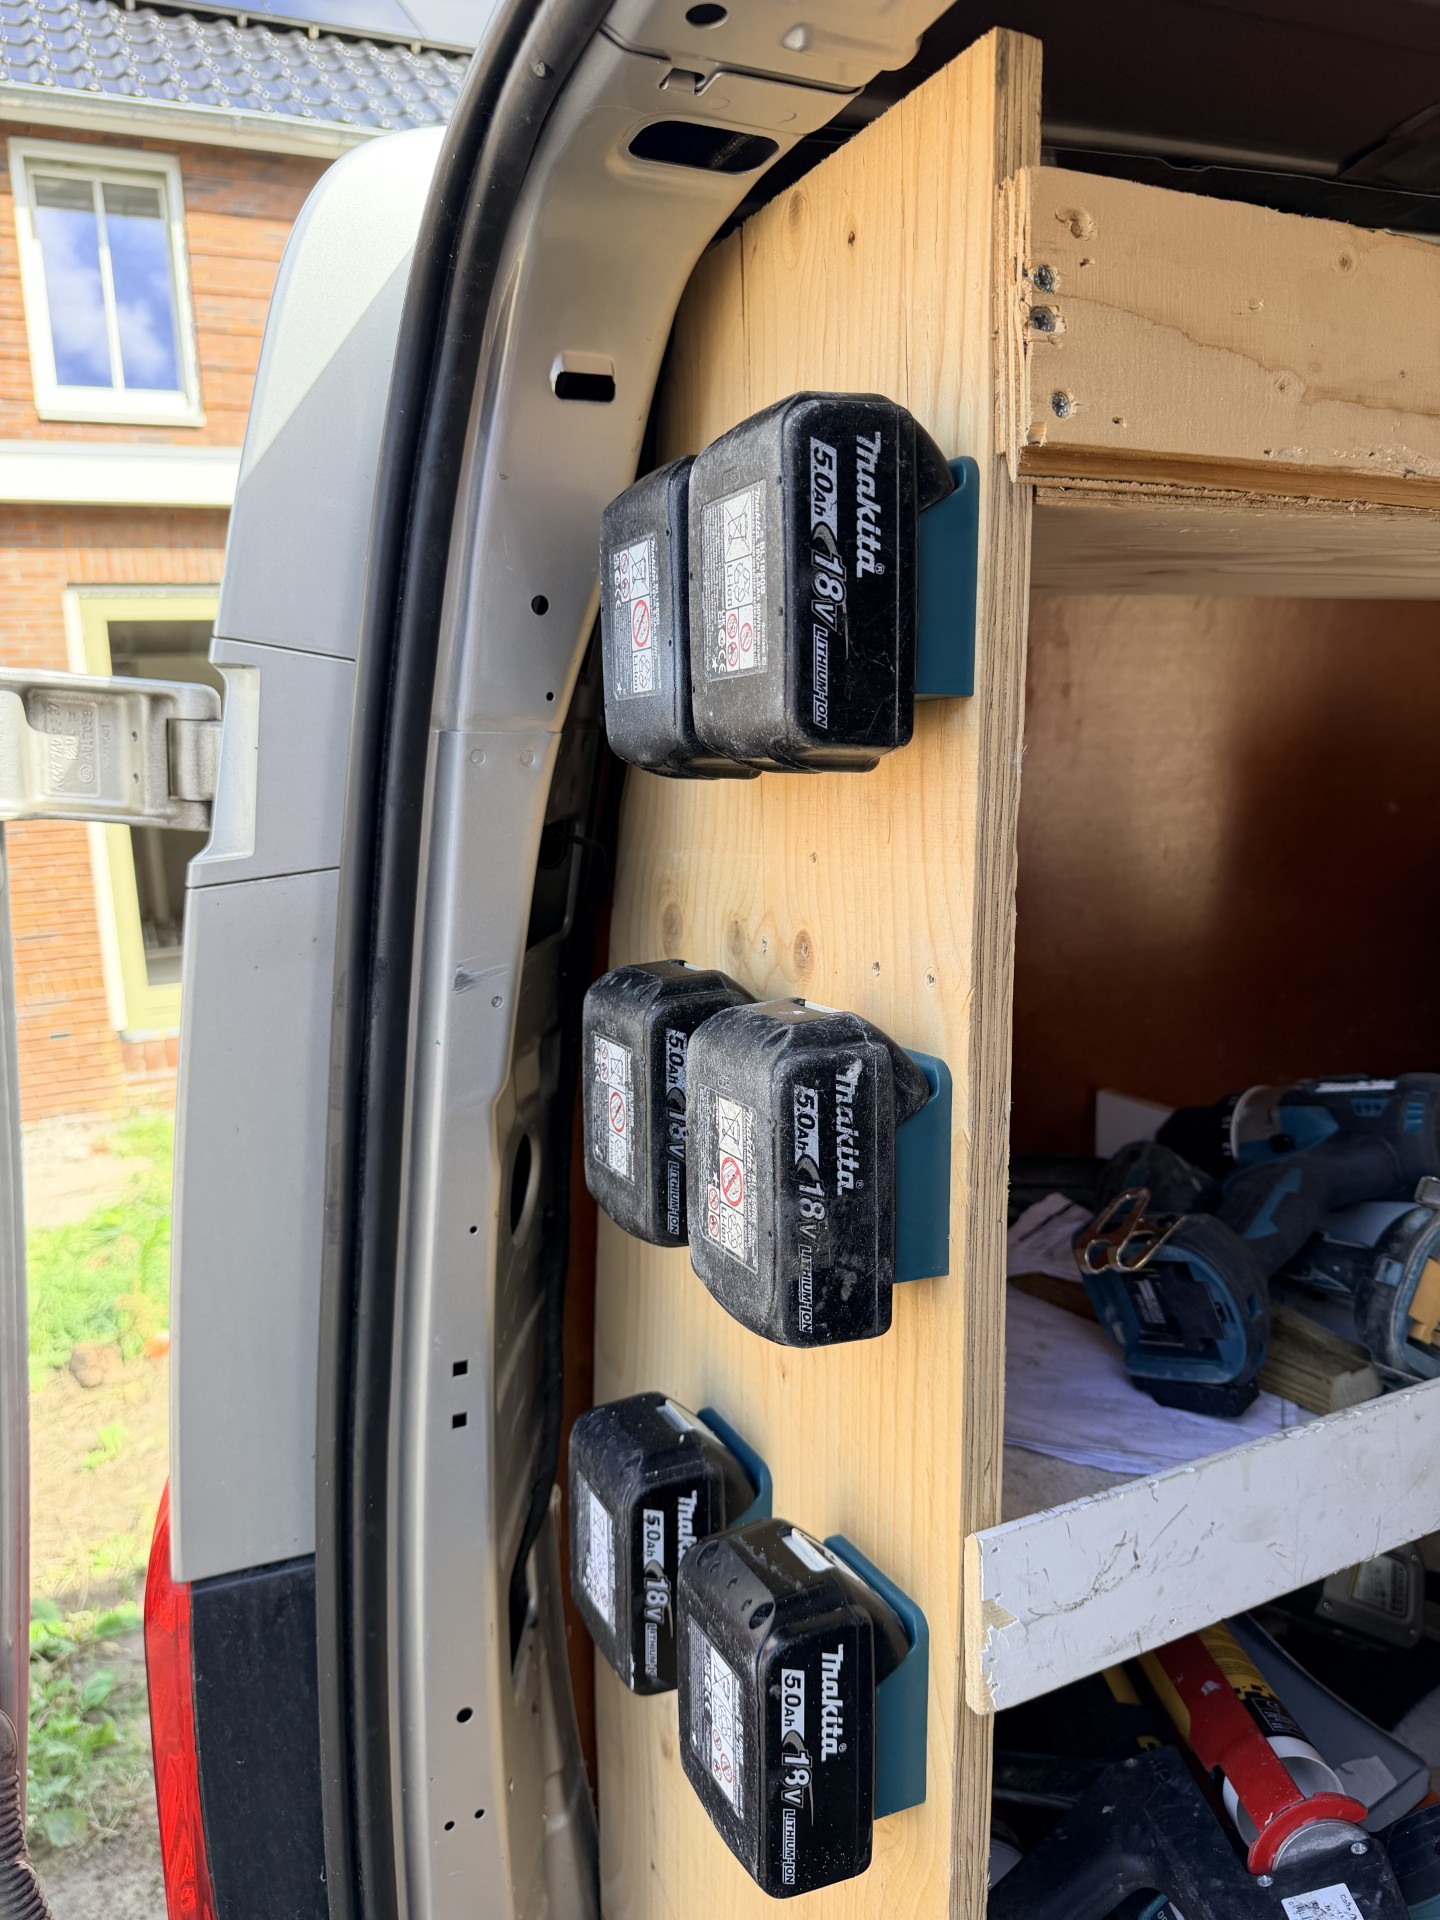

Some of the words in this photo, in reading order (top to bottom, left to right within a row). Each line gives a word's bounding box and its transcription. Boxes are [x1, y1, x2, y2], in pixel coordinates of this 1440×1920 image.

[812, 446, 834, 518] 5.0Ah
[811, 549, 847, 632] 18V
[813, 624, 829, 729] LITHIUM-ION
[667, 1106, 687, 1161] 18V
[798, 1177, 828, 1242] 18V
[645, 1513, 661, 1557] 5.0Ah
[644, 1576, 670, 1625] 18V
[784, 1673, 802, 1728] 5.0Ah
[782, 1808, 796, 1885] LITHIUM-ION
